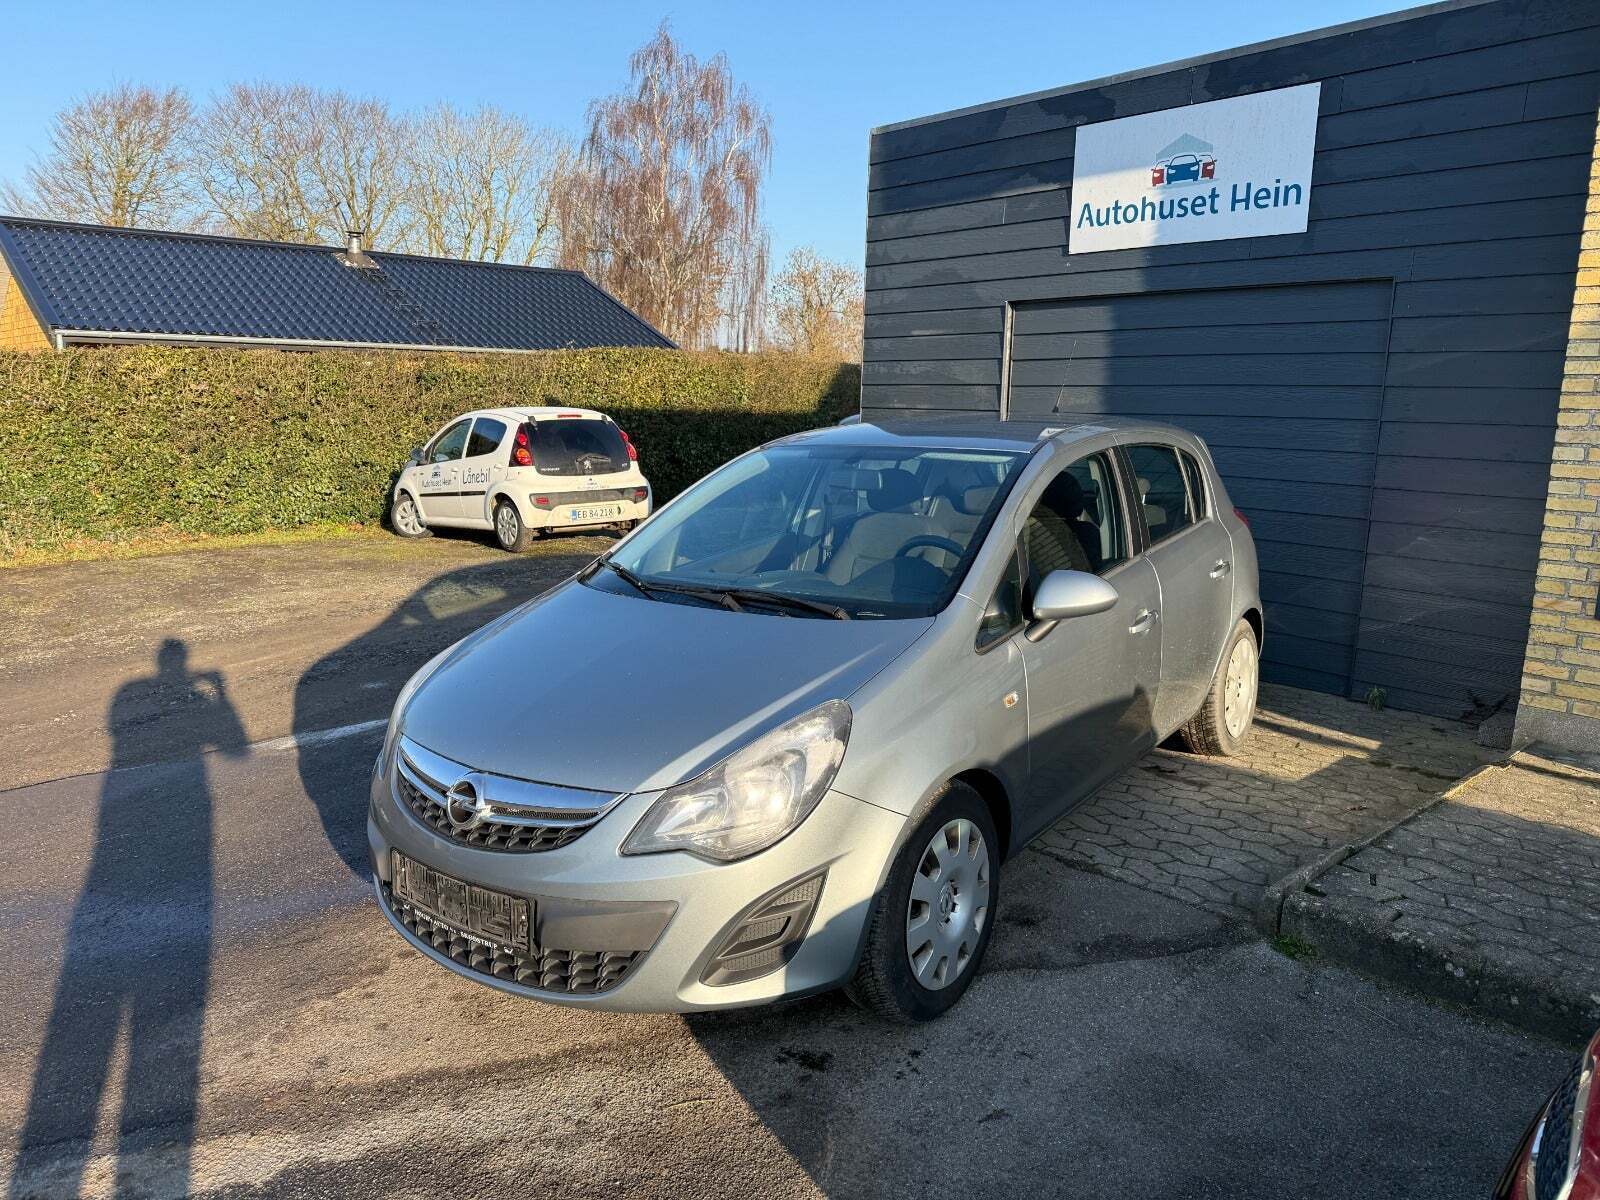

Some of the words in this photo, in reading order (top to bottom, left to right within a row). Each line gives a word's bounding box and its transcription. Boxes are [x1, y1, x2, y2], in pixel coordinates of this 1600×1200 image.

[1077, 187, 1220, 229] Autohuset
[1230, 178, 1302, 212] Hein
[462, 467, 491, 484] Lånebil
[577, 510, 588, 519] EB
